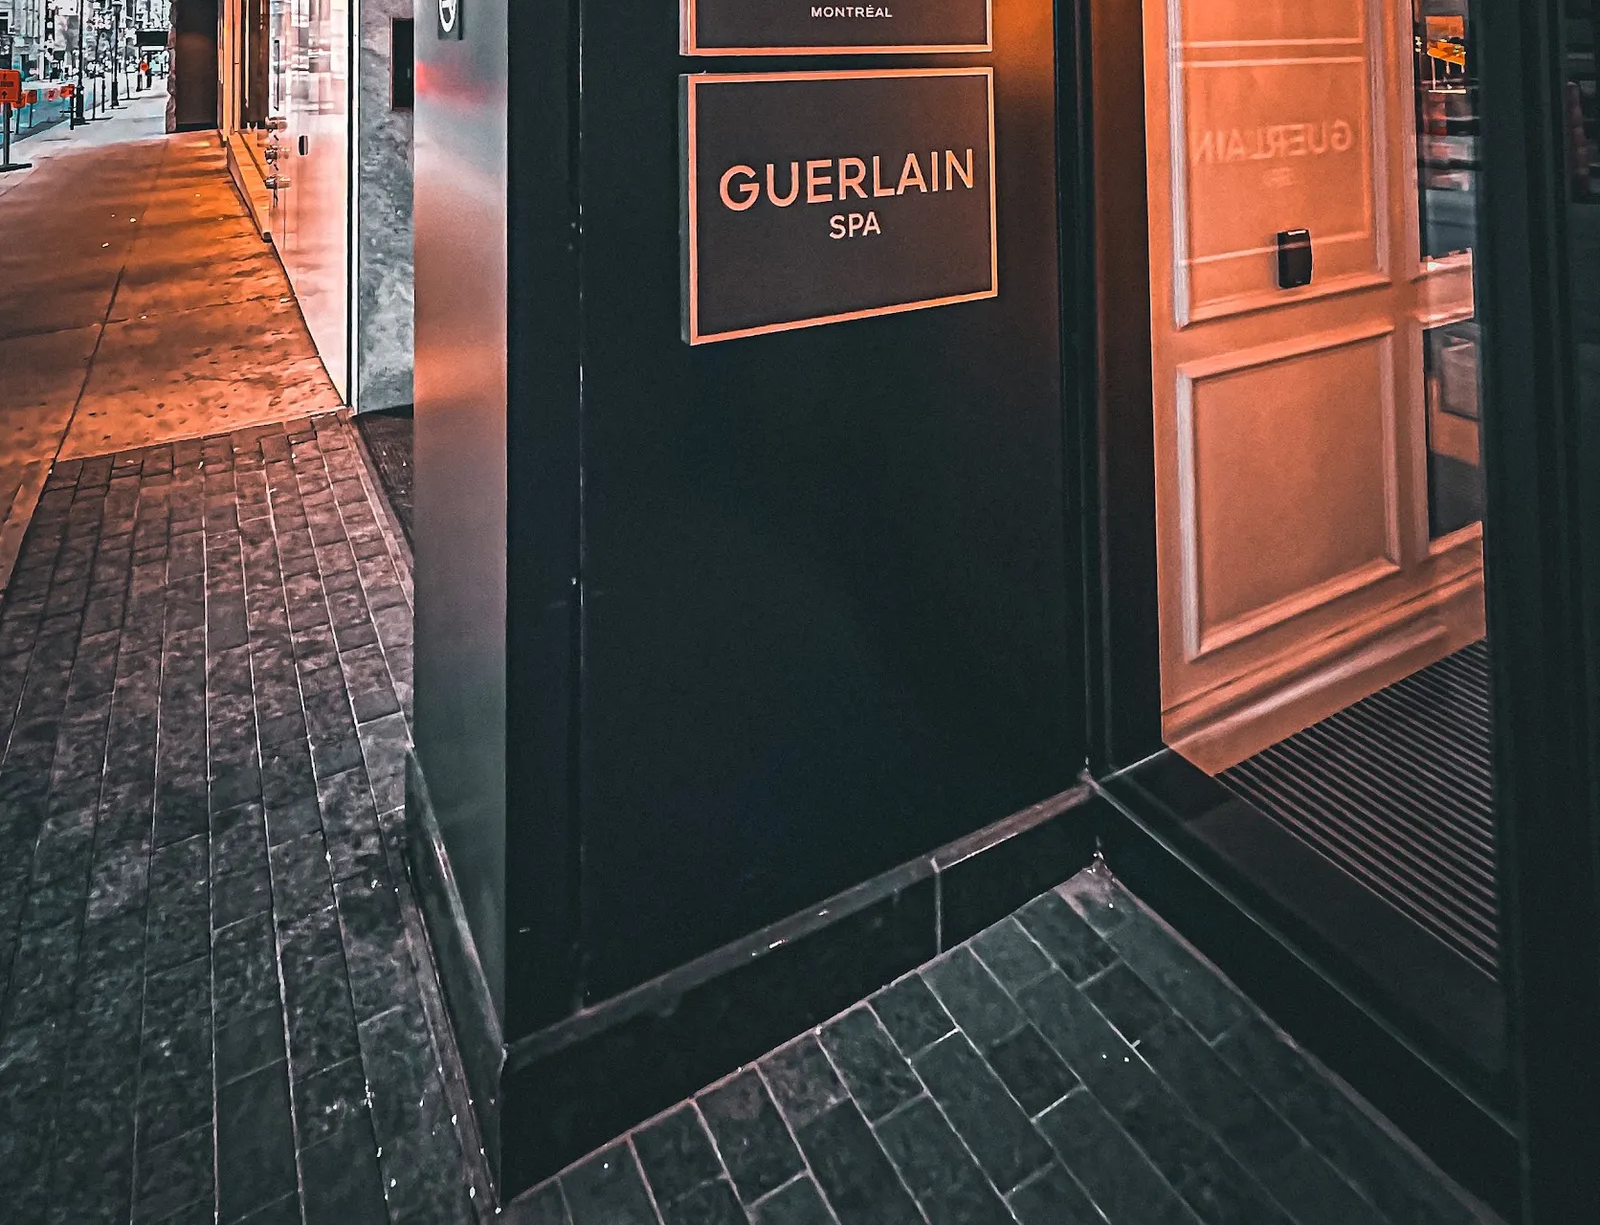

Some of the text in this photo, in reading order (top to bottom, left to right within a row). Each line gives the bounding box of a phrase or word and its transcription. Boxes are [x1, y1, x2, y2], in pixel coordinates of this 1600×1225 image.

[810, 4, 893, 19] MONTRÉAL
[719, 148, 975, 212] GUERLAIN
[828, 210, 882, 241] SPA
